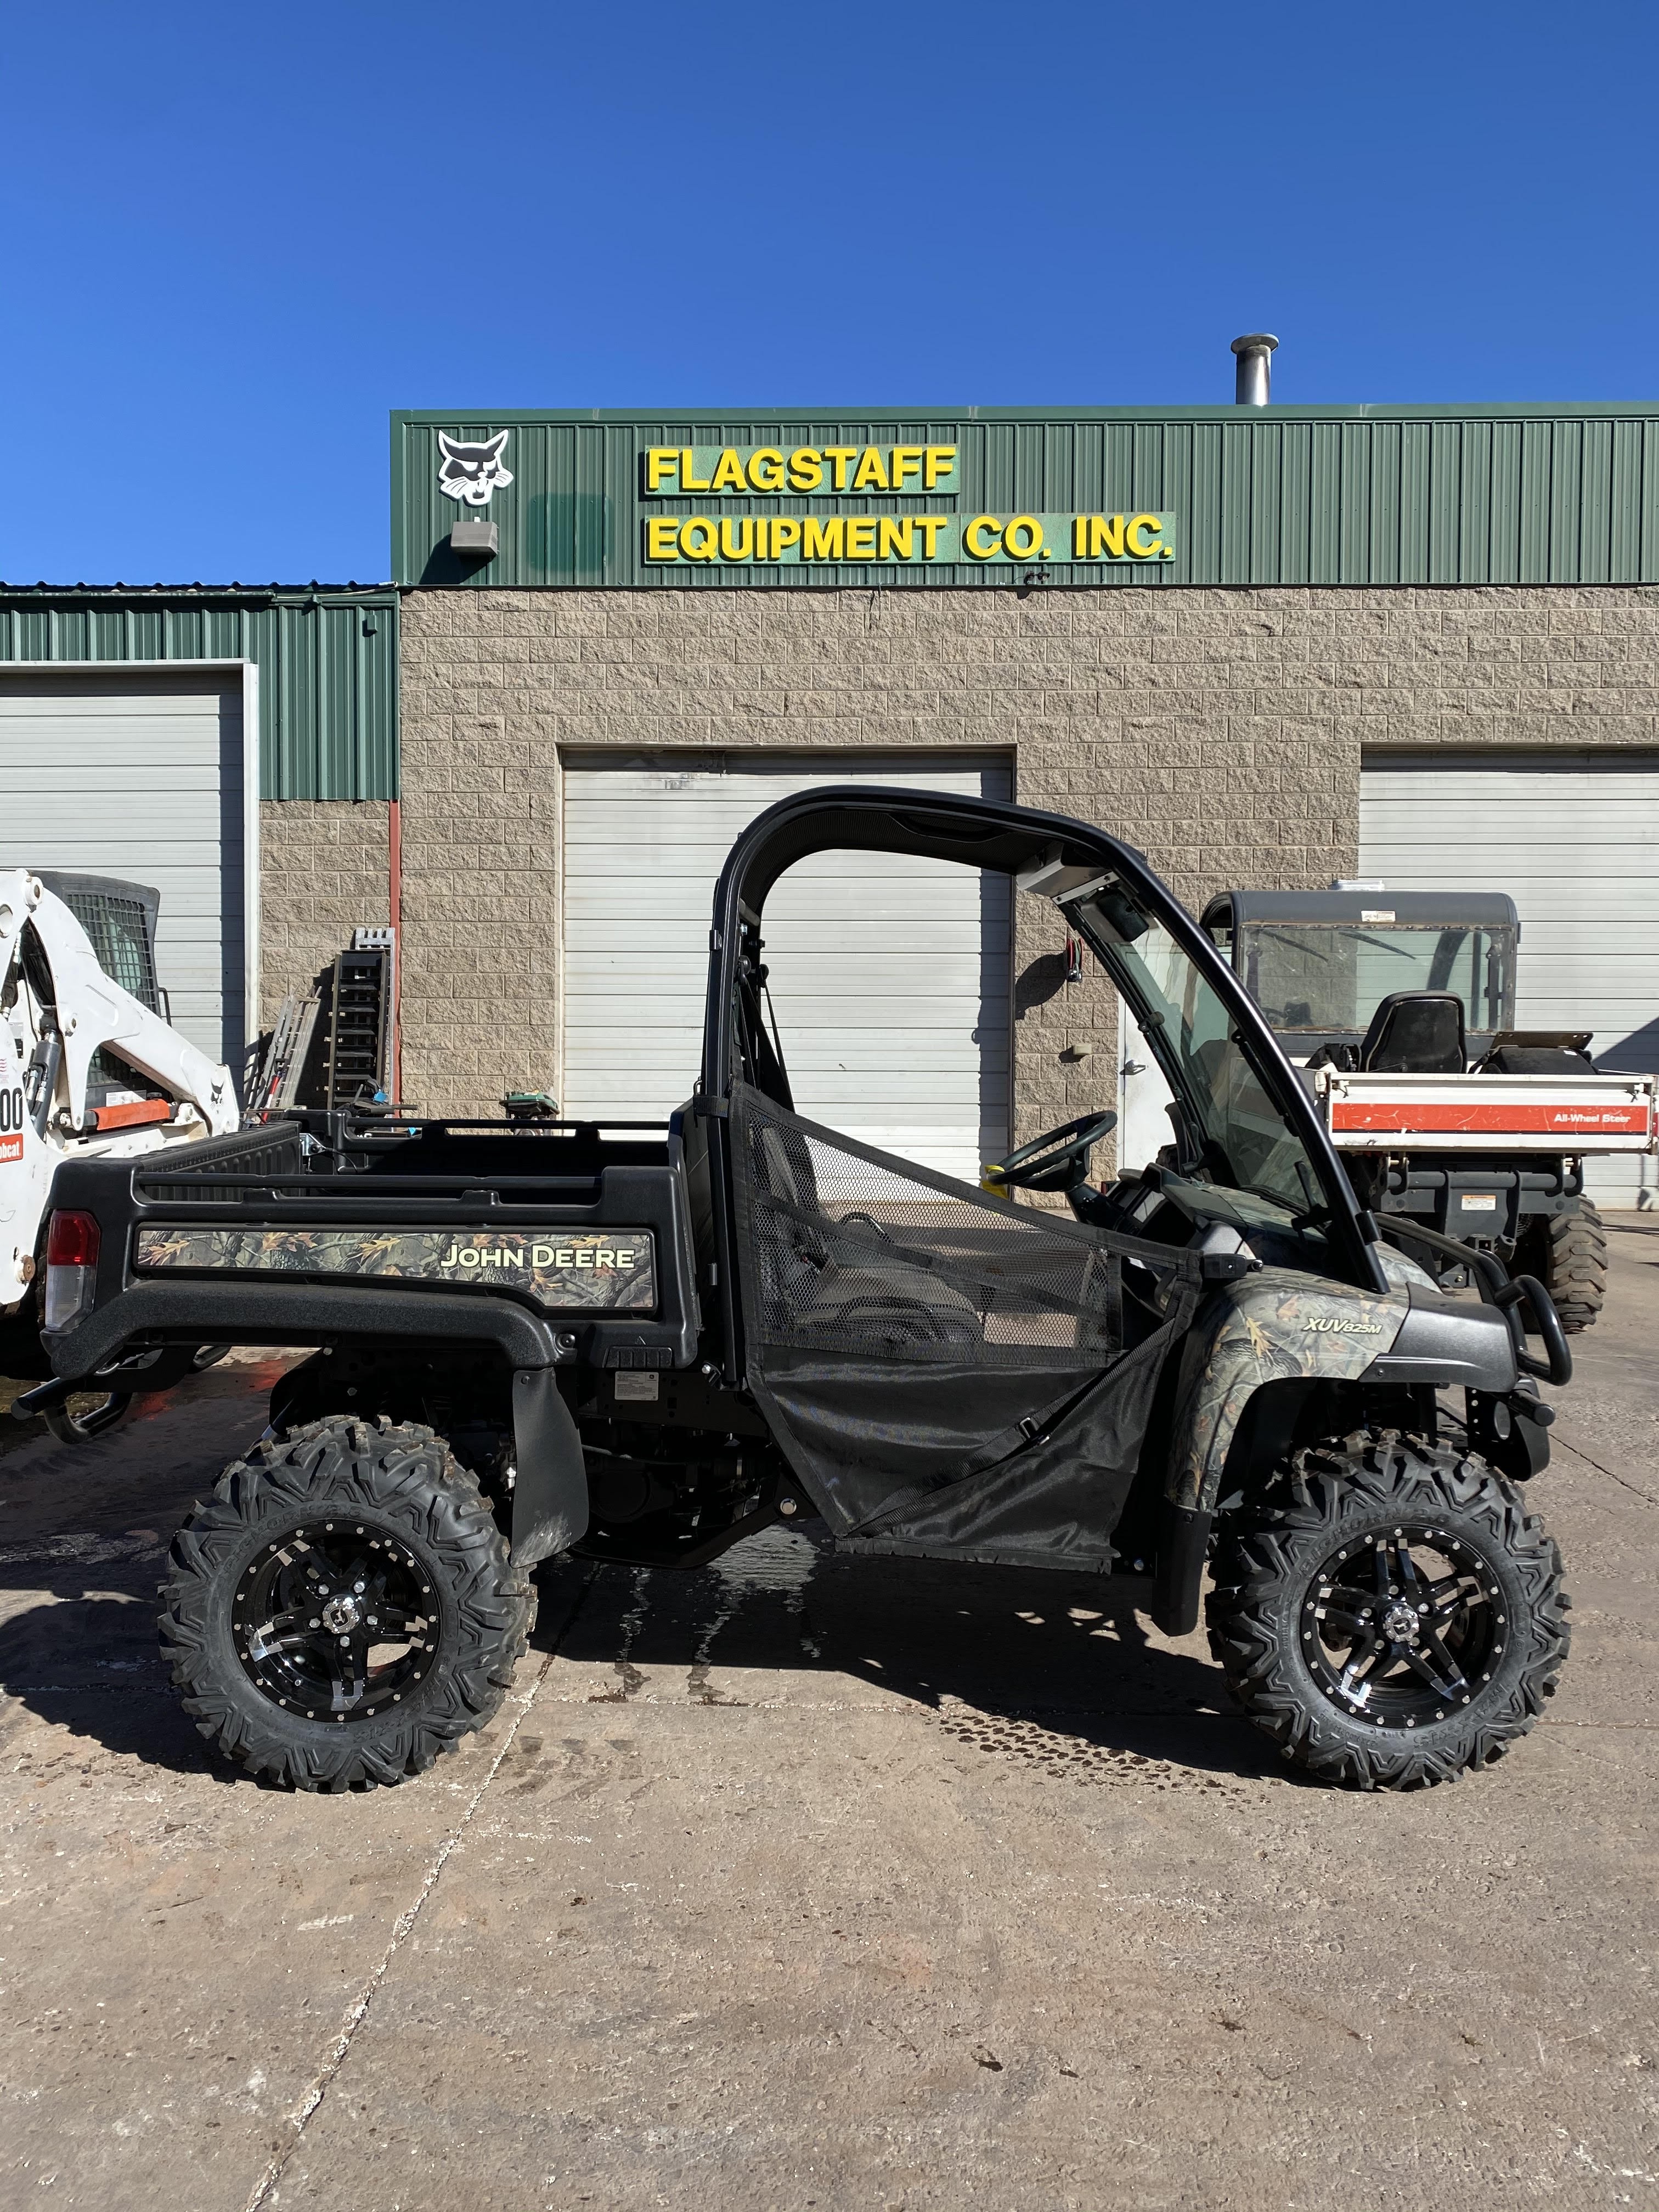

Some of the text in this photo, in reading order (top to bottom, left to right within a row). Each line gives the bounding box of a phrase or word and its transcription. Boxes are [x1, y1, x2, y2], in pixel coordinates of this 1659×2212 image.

[648, 447, 956, 490] FLAGSTAFF
[649, 514, 1172, 562] EQUIPMENT CO. INC.
[1554, 1114, 1631, 1122] All-Wheel Steer
[441, 1244, 635, 1268] JOHN DEERE
[1302, 1317, 1383, 1334] XUV825M
